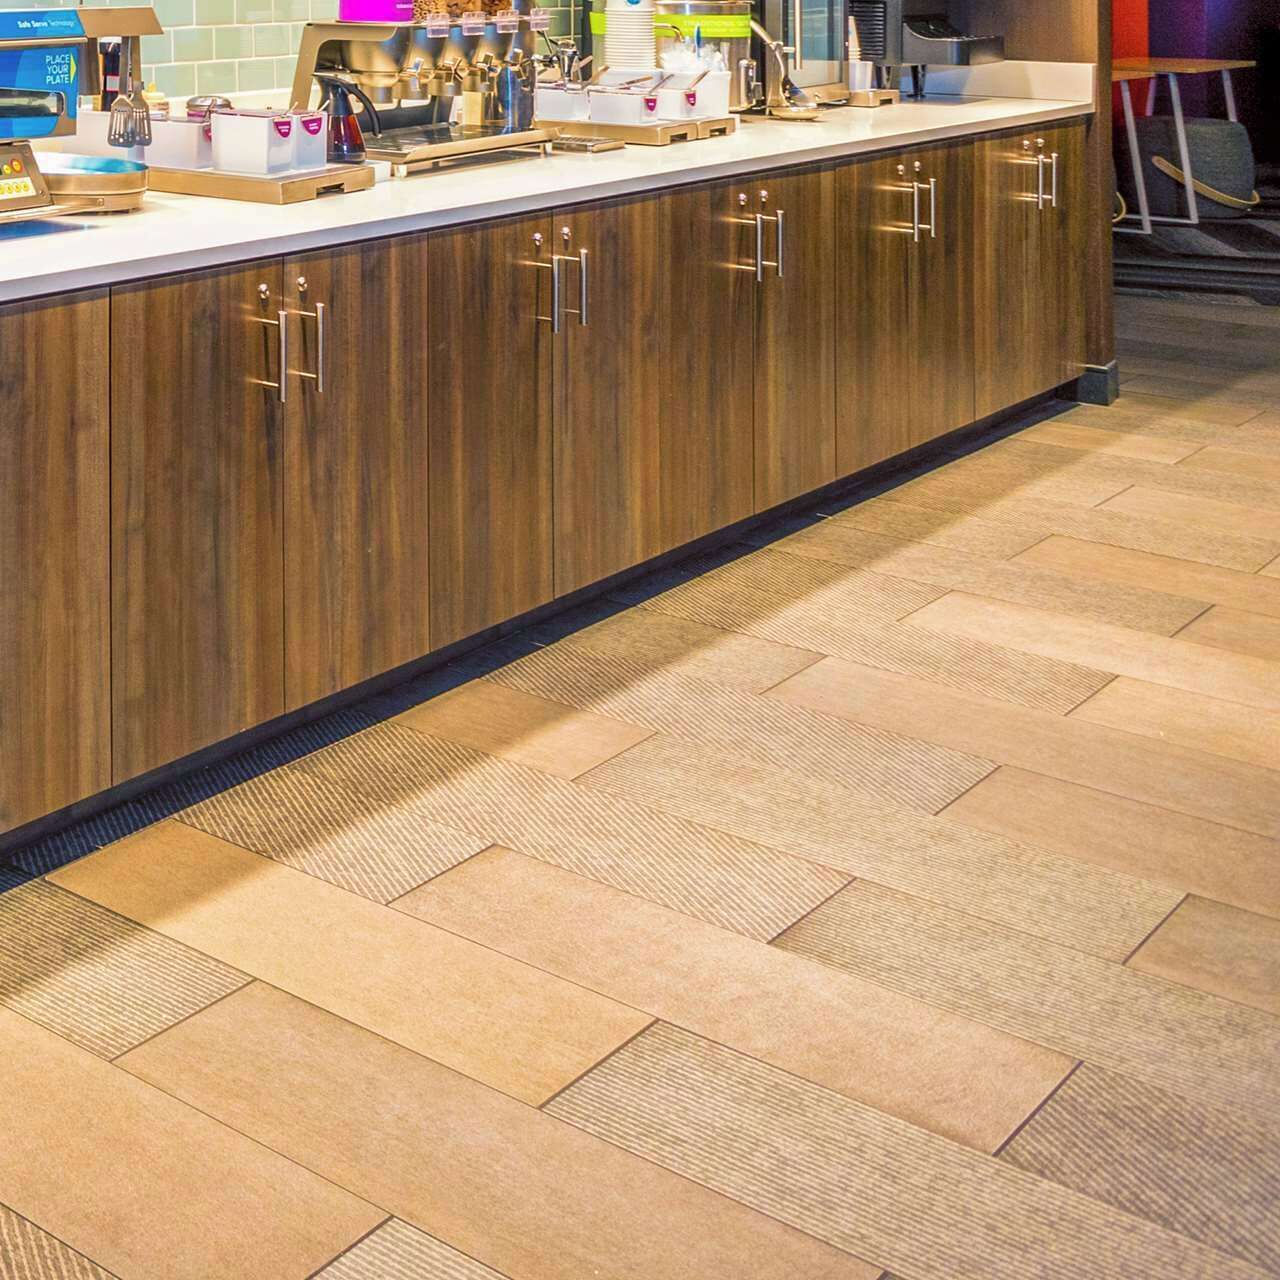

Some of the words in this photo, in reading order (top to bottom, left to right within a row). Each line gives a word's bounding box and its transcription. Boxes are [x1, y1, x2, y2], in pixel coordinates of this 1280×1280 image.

[45, 54, 70, 64] PLACE
[47, 64, 69, 74] YOUR
[46, 74, 70, 85] PLATE
